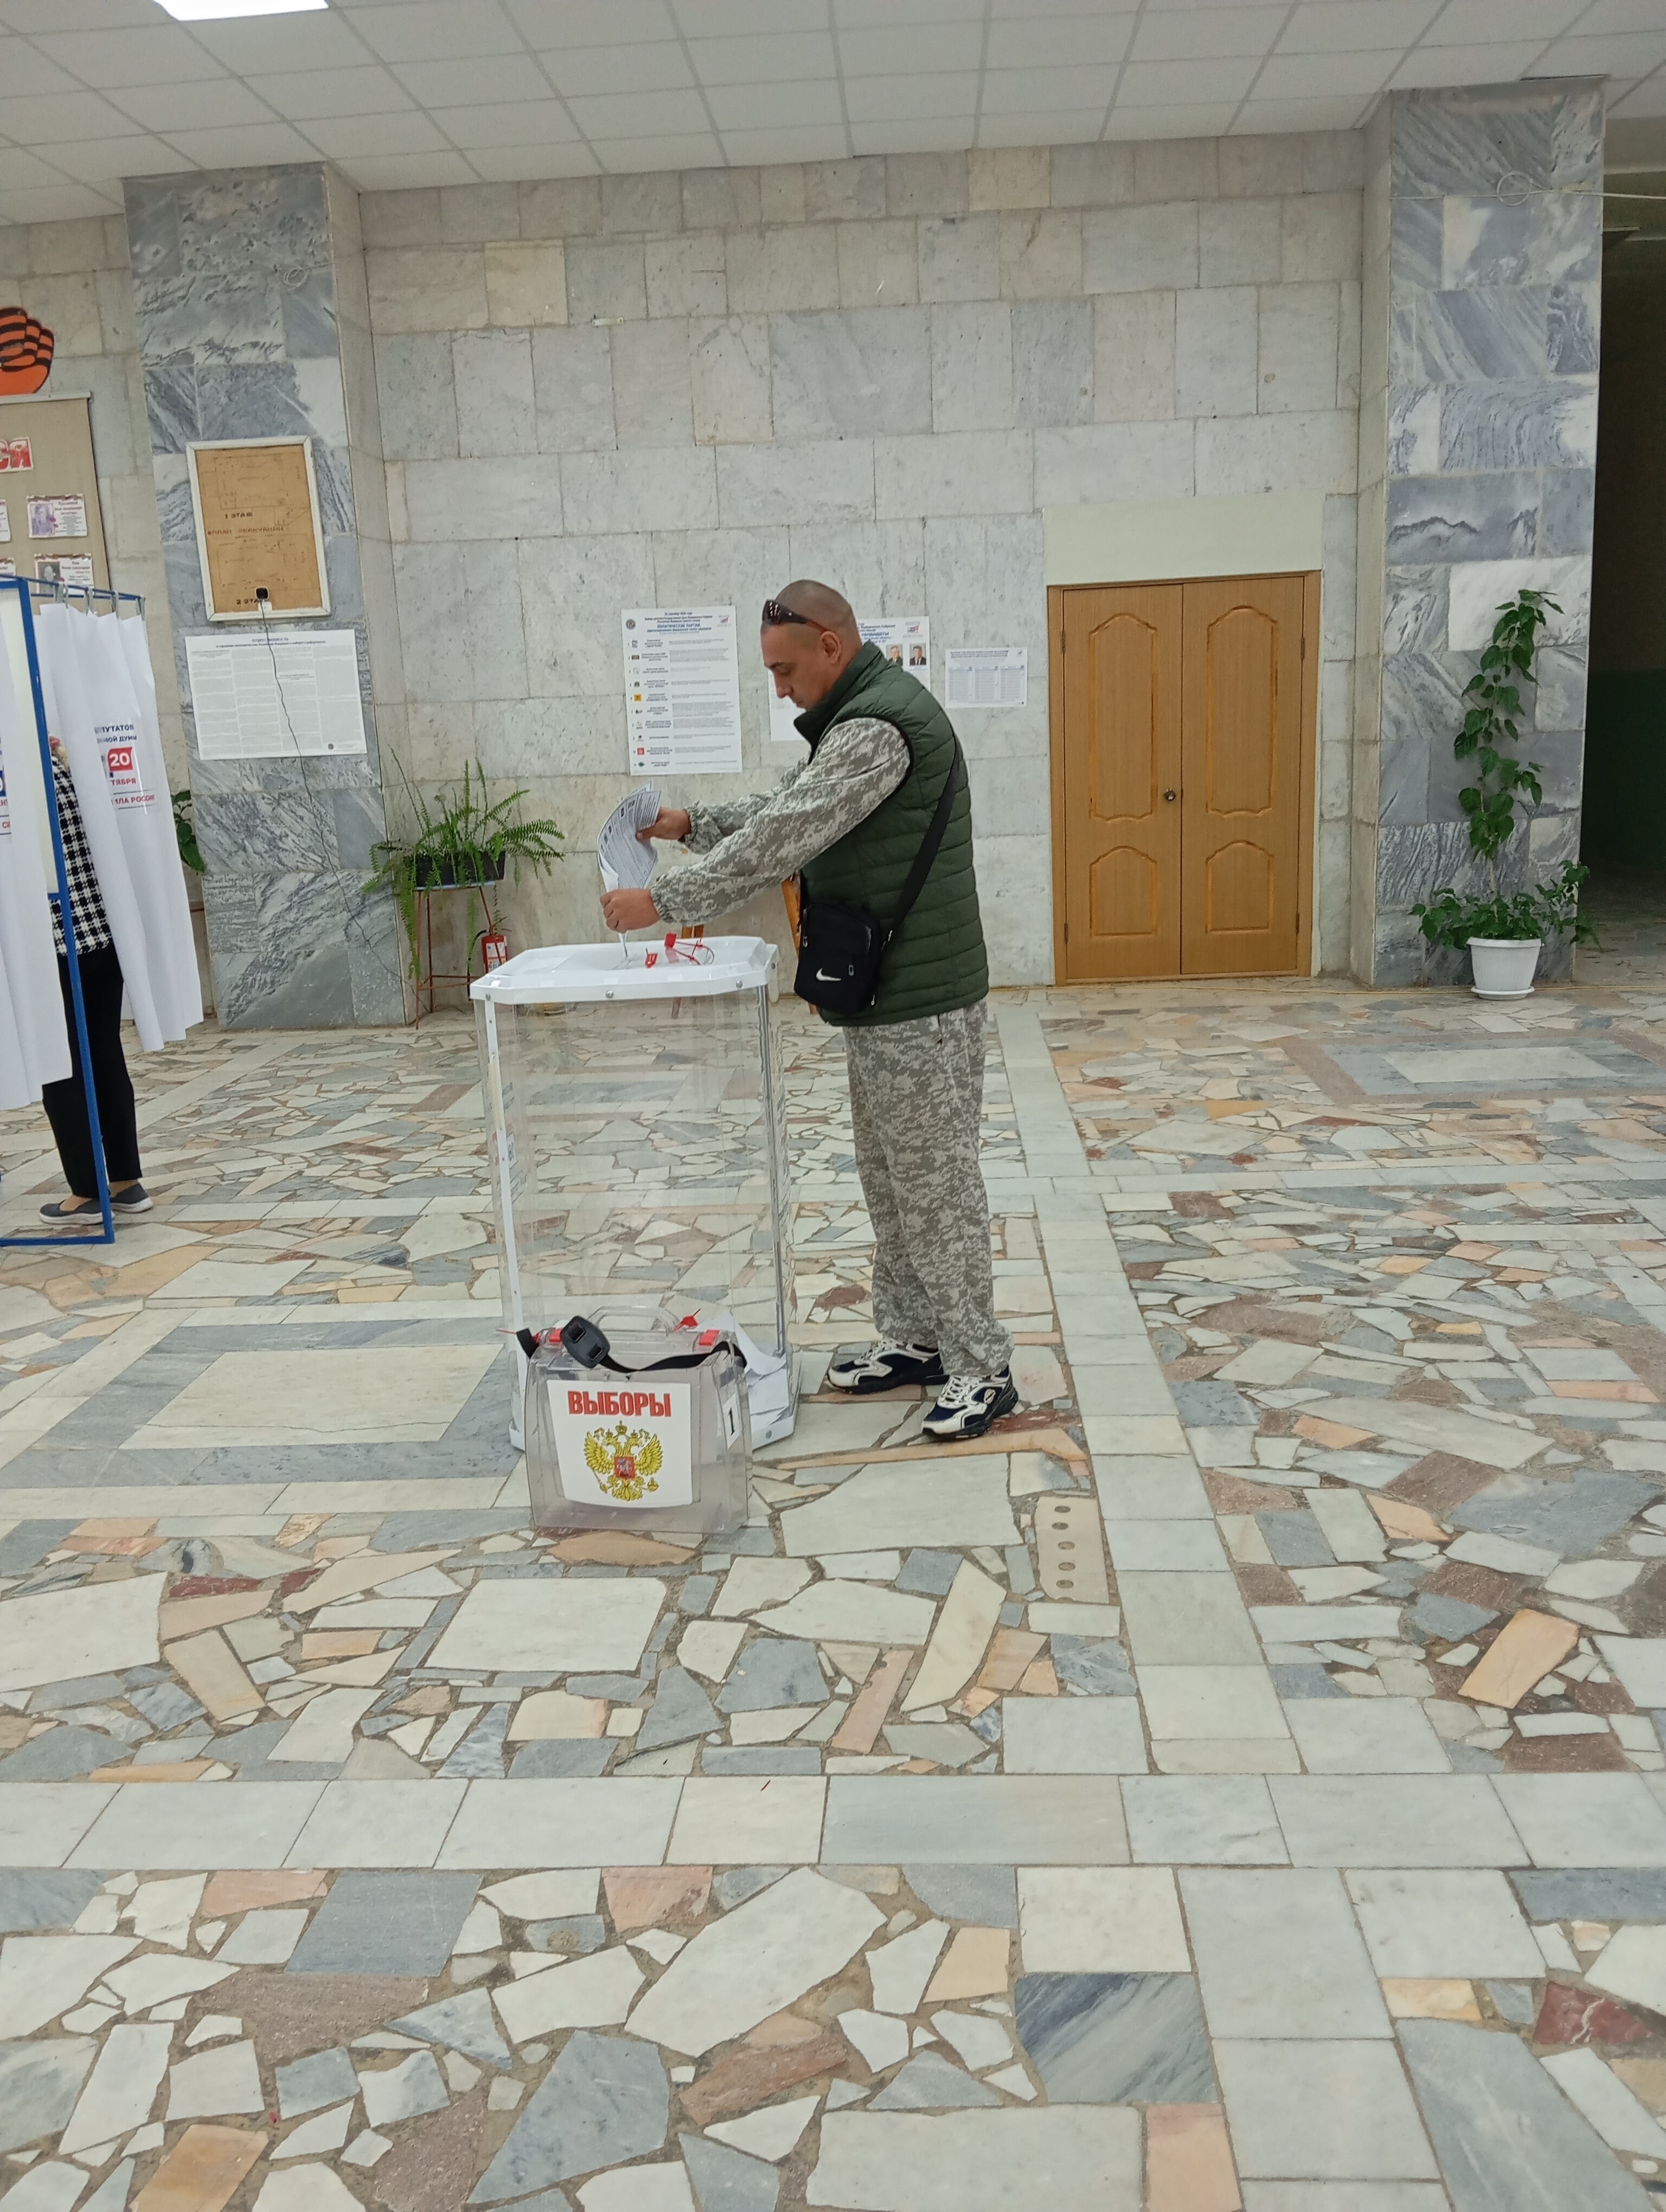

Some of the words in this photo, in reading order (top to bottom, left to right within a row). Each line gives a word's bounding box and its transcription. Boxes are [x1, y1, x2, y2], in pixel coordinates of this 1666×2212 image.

[108, 752, 131, 768] 20
[111, 777, 137, 786] ТЯБРЯ
[567, 1390, 672, 1417] ВЫБОРЫ
[728, 1407, 736, 1436] 1
